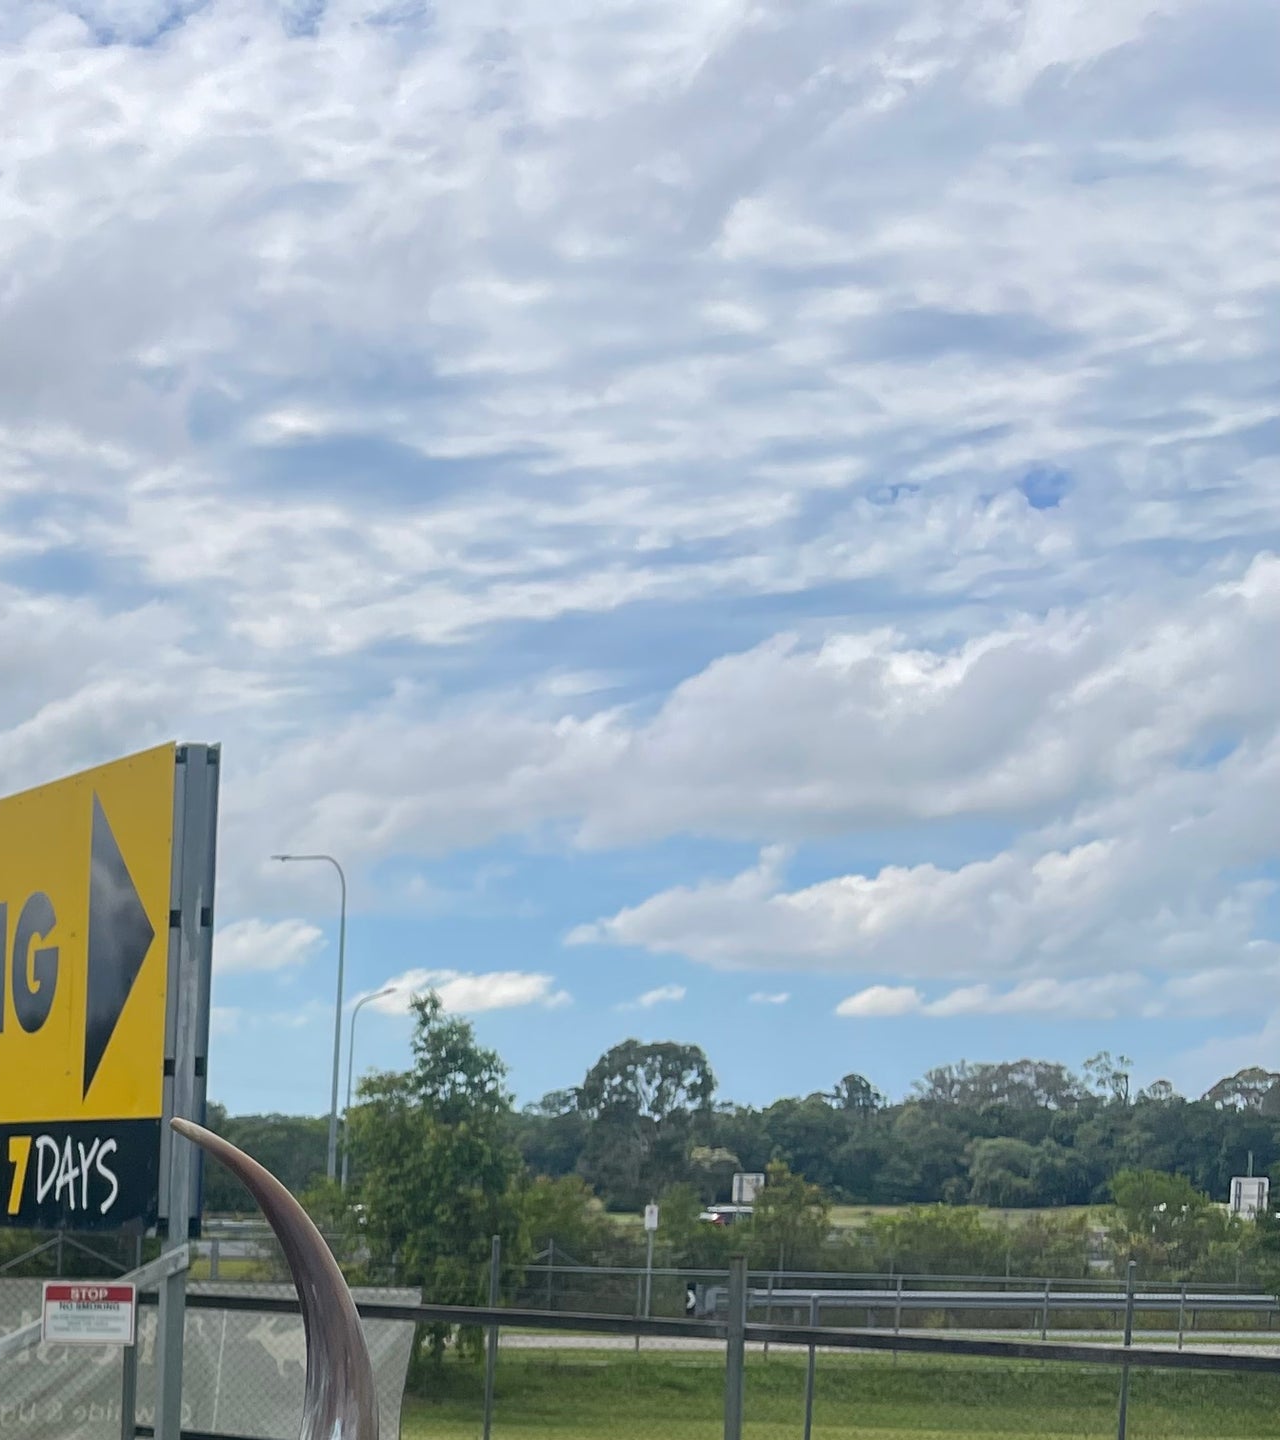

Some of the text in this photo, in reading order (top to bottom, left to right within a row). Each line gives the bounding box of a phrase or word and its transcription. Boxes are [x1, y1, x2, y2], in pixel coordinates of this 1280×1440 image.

[8, 1136, 32, 1215] 7
[36, 1135, 118, 1214] DAYS
[71, 1287, 108, 1301] STOP
